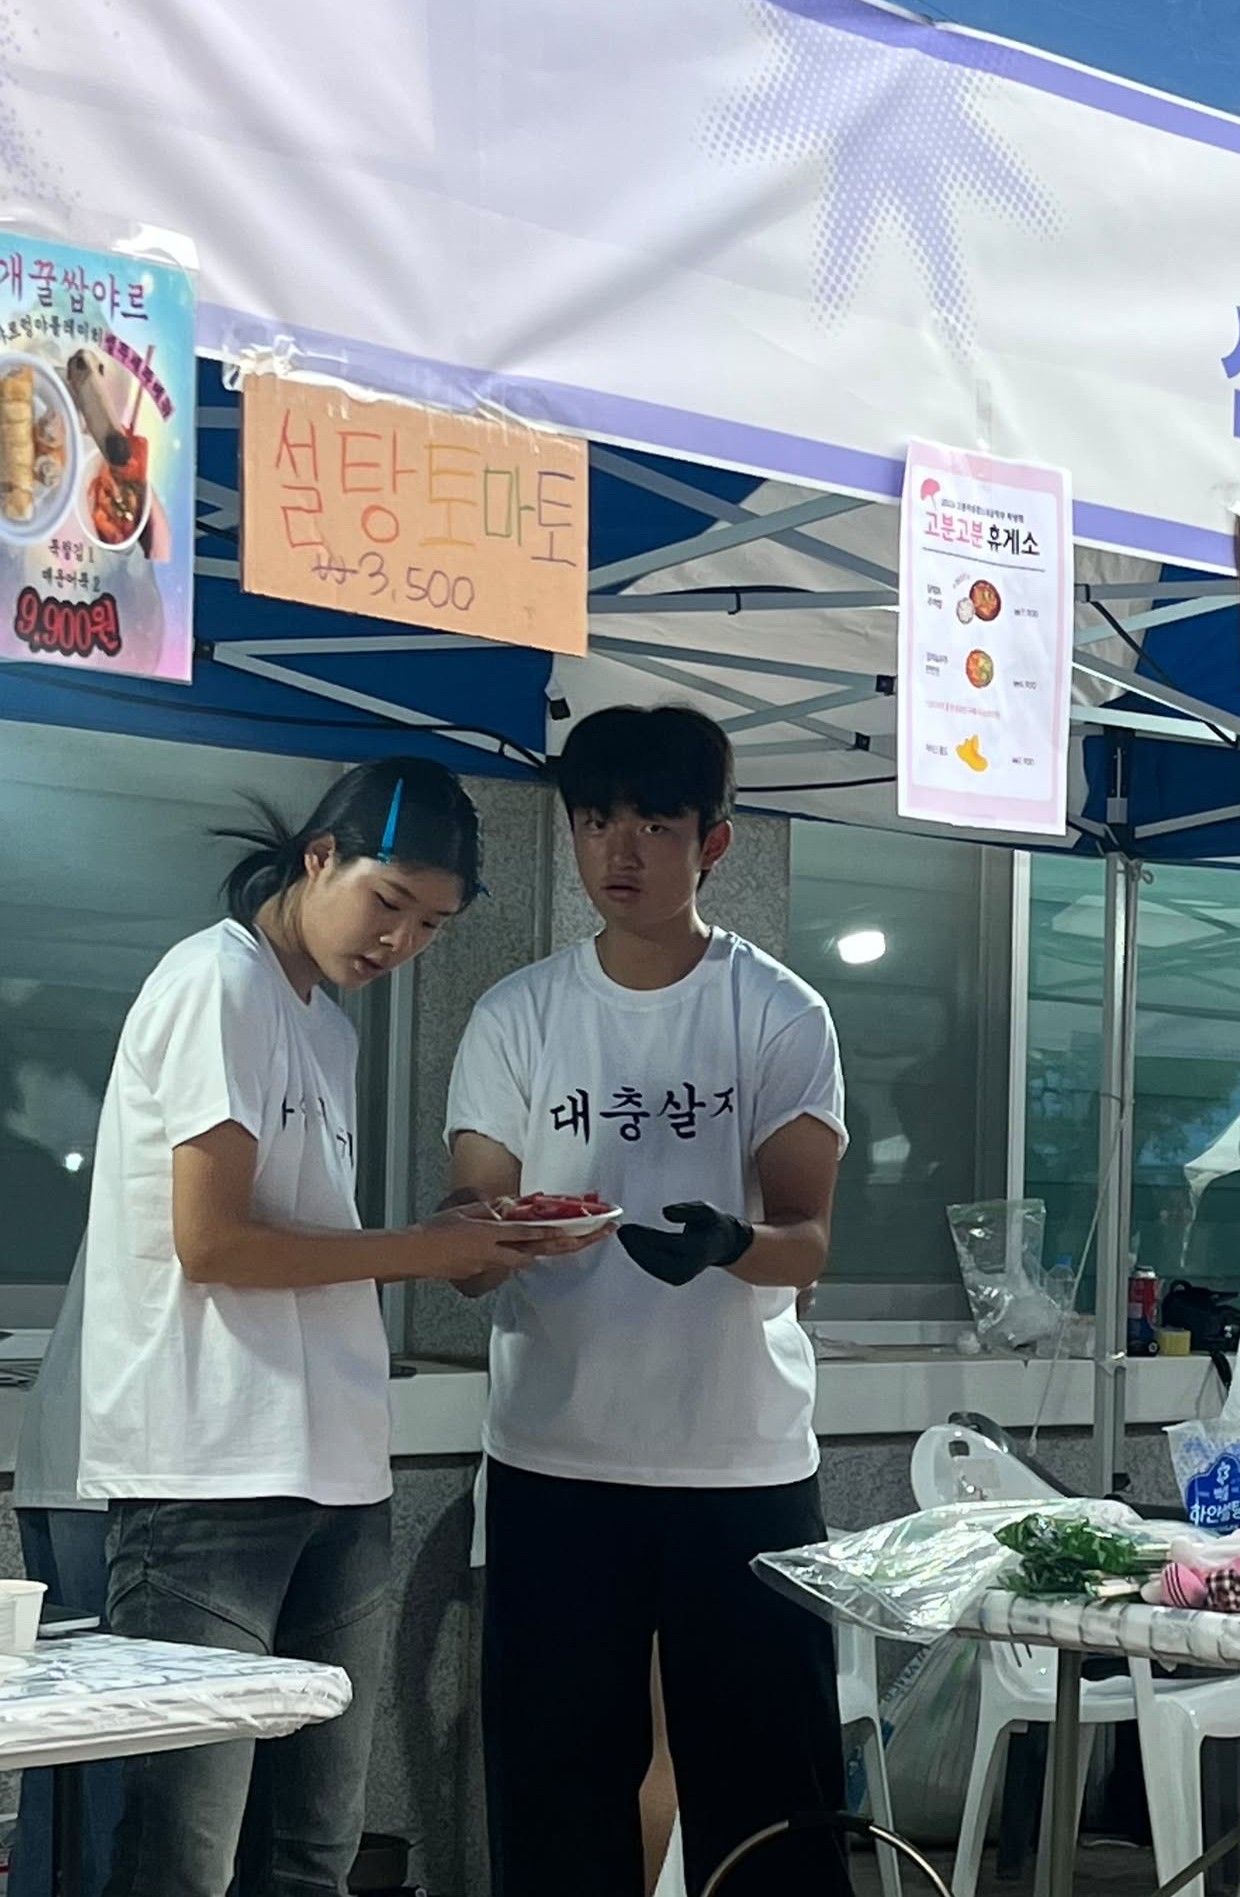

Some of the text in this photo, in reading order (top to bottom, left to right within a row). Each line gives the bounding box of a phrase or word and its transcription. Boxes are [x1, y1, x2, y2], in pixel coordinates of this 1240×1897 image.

[275, 408, 577, 567] 설탕토마토
[923, 511, 984, 549] 고분고분
[986, 523, 1041, 556] 휴게소
